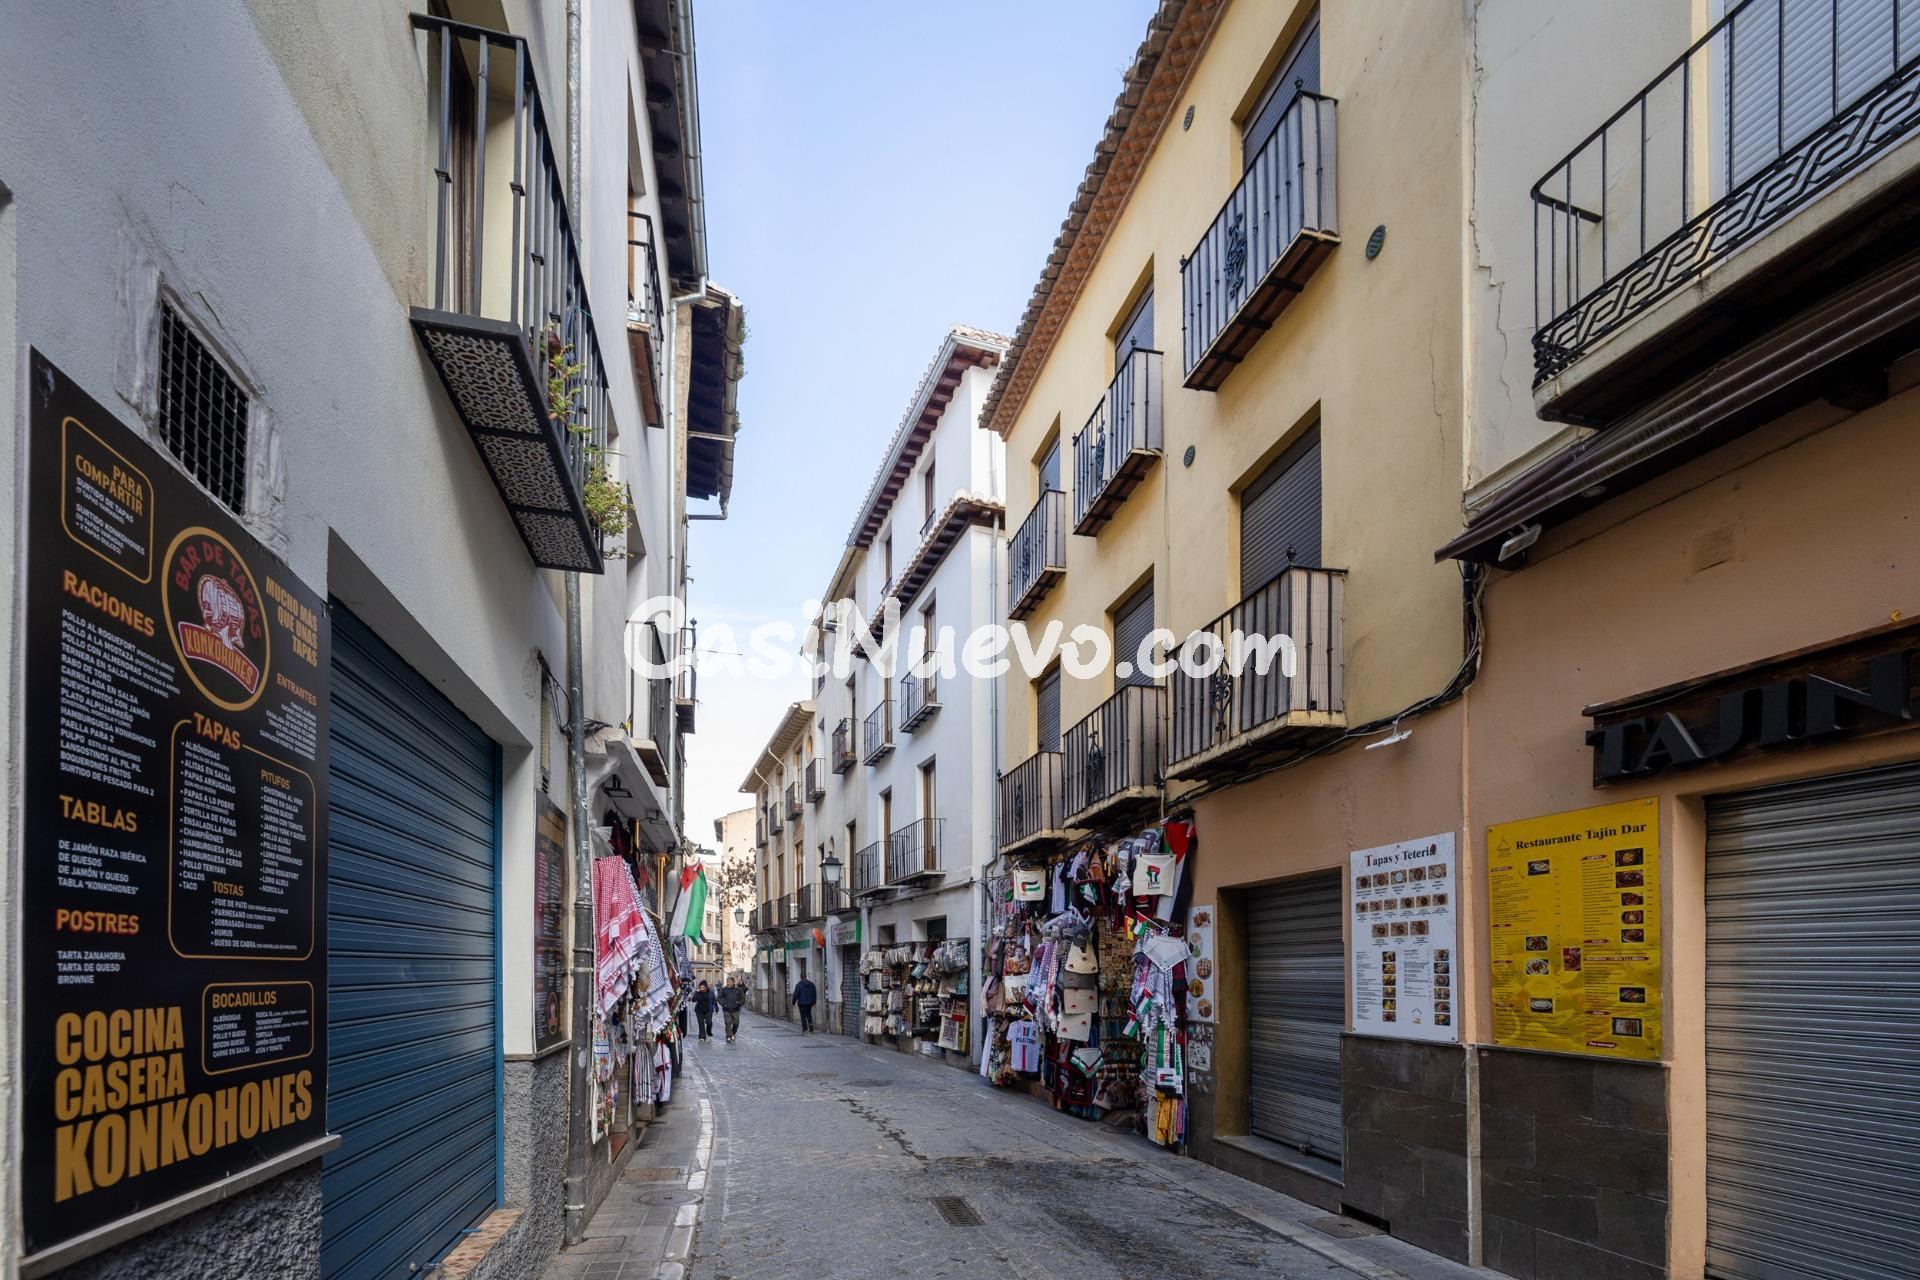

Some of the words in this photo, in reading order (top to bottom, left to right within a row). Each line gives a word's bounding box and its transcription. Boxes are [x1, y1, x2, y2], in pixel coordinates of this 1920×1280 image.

[75, 451, 142, 517] COMPARTIR
[113, 464, 142, 501] PARA
[76, 475, 104, 503] SURTIDO
[105, 496, 113, 510] DE
[115, 503, 133, 524] TAPAS
[76, 501, 103, 528] SURTIDO
[176, 545, 200, 592] BAR
[201, 541, 224, 567] DE
[230, 559, 262, 639] TAPAS
[265, 574, 298, 617] MUCHO
[300, 600, 317, 632] MÁS
[64, 568, 154, 640] RACIONES
[61, 619, 85, 638] POLLO
[87, 632, 92, 641] A
[93, 636, 102, 647] LA
[104, 641, 133, 662] MOSTAZA
[62, 608, 85, 628] POLLO
[87, 621, 96, 633] AL
[98, 627, 135, 653] ROQUEFORT
[277, 603, 294, 634] QUE
[295, 618, 317, 651] UNAS
[61, 631, 85, 649] POLLO
[87, 643, 101, 657] CON
[102, 651, 141, 676] ALMENDRAS
[61, 641, 94, 664] TERNERA
[96, 658, 105, 669] EN
[107, 663, 128, 680] SALSA
[185, 628, 252, 684] KONKOHONES
[291, 634, 316, 668] TAPAS
[61, 653, 81, 669] RABO
[83, 663, 92, 674] DE
[94, 668, 111, 683] TORO
[61, 664, 105, 691] CARRILLADA
[107, 684, 116, 695] EN
[118, 689, 138, 705] SALSA
[61, 675, 89, 695] HUEVOS
[91, 688, 113, 704] ROTOS
[114, 697, 127, 710] CON
[129, 702, 150, 720] JAMÓN
[276, 671, 316, 707] ENTRANTES
[60, 685, 83, 703] PLATO
[85, 695, 133, 723] ALPUJARREÑO
[1586, 650, 1912, 775] TAJIN
[60, 705, 113, 732] HAMBURGUESA
[60, 716, 88, 734] PAELLA
[90, 727, 107, 741] PARA
[110, 735, 113, 743] 2
[194, 711, 240, 751] TAPAS
[60, 739, 108, 762] LANGOSTINOS
[110, 756, 118, 765] AL
[120, 759, 130, 769] PIL
[131, 763, 141, 772] PIL
[184, 738, 220, 761] ALBÓNDIGAS
[60, 750, 107, 772] BOQUERONES
[109, 766, 130, 779] FRITOS
[184, 758, 204, 772] ALITAS
[205, 766, 212, 776] EN
[214, 769, 231, 782] SALSA
[60, 761, 90, 778] SURTIDO
[92, 771, 101, 781] DE
[103, 774, 132, 790] PESCADO
[133, 783, 148, 795] PARA
[150, 788, 154, 796] 2
[184, 769, 202, 783] PAPAS
[204, 776, 235, 794] ARRUGADAS
[260, 768, 289, 790] PITUFOS
[183, 788, 202, 800] PAPAS
[203, 794, 207, 802] A
[208, 796, 215, 805] LO
[217, 798, 235, 811] POBRE
[59, 794, 136, 833] TABLAS
[183, 805, 209, 820] TORTILLA
[211, 813, 217, 822] DE
[219, 816, 236, 827] PAPAS
[183, 816, 221, 833] ENSALADILLA
[223, 827, 236, 837] RUSA
[183, 826, 223, 844] CHAMPIÑONES
[183, 838, 224, 854] HAMBURGUESA
[226, 847, 241, 858] POLLO
[1516, 832, 1582, 850] Restaurante
[1585, 827, 1617, 841] Tajin
[1621, 823, 1647, 835] Dar
[58, 837, 69, 850] DE
[71, 840, 98, 855] JAMÓN
[100, 845, 118, 859] RAZA
[120, 849, 146, 864] IBÉRICA
[58, 851, 69, 862] DE
[71, 853, 102, 867] QUESOS
[183, 848, 224, 864] HAMBURGUESA
[225, 857, 242, 868] CERDO
[1365, 854, 1393, 867] Tapas
[1394, 854, 1400, 865] y
[57, 863, 69, 874] DE
[71, 866, 97, 878] JAMÓN
[99, 870, 104, 879] Y
[105, 871, 129, 883] QUESO
[57, 876, 83, 888] TABLA
[85, 880, 138, 895] "KONKOHONES"
[183, 870, 205, 881] CALLOS
[183, 881, 197, 890] TACO
[212, 880, 243, 896] TOSTAS
[214, 898, 226, 906] FOIE
[214, 908, 245, 918] PARMESANO
[56, 908, 139, 934] POSTRES
[214, 919, 244, 927] SOBRASADA
[56, 950, 81, 959] TARTA
[84, 951, 125, 960] ZANAHORIA
[56, 962, 81, 972] TARTA
[84, 963, 93, 971] DE
[96, 963, 120, 971] QUESO
[57, 975, 94, 984] BROWNIE
[212, 991, 276, 1008] BOCADILLOS
[213, 1013, 240, 1022] ALBÓNDIGAS
[213, 1022, 237, 1031] CHISTORRA
[55, 1006, 185, 1065] COCINA
[212, 1049, 227, 1057] CARNE
[236, 1046, 249, 1054] SALSA
[55, 1052, 186, 1122] CASERA
[55, 1069, 313, 1203] KONKOHONES
